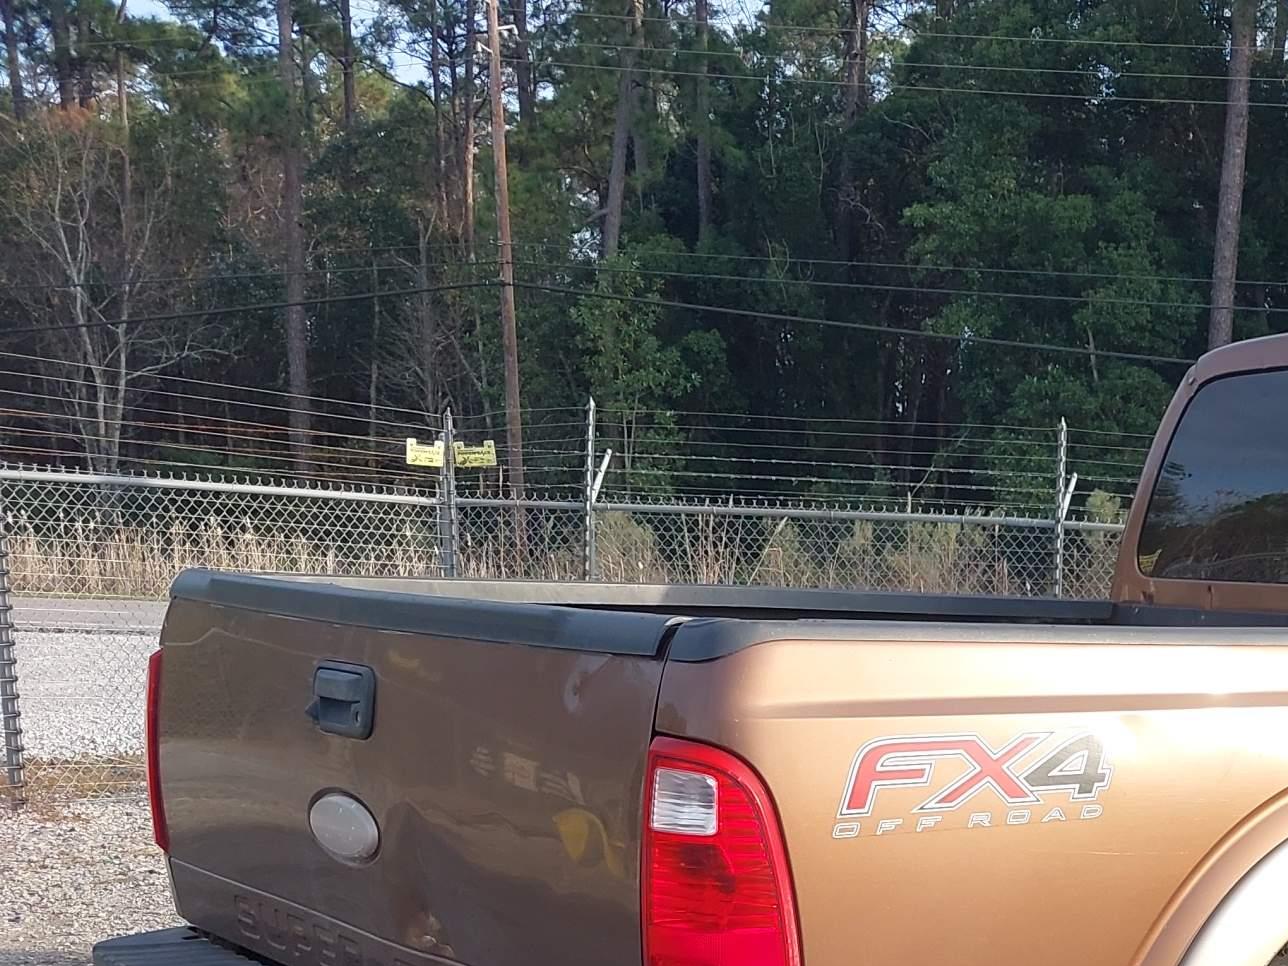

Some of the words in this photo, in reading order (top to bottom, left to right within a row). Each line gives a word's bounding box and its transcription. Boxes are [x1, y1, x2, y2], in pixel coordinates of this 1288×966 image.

[836, 728, 1114, 819] FX4
[831, 816, 943, 840] OFF
[967, 803, 1105, 829] ROAD
